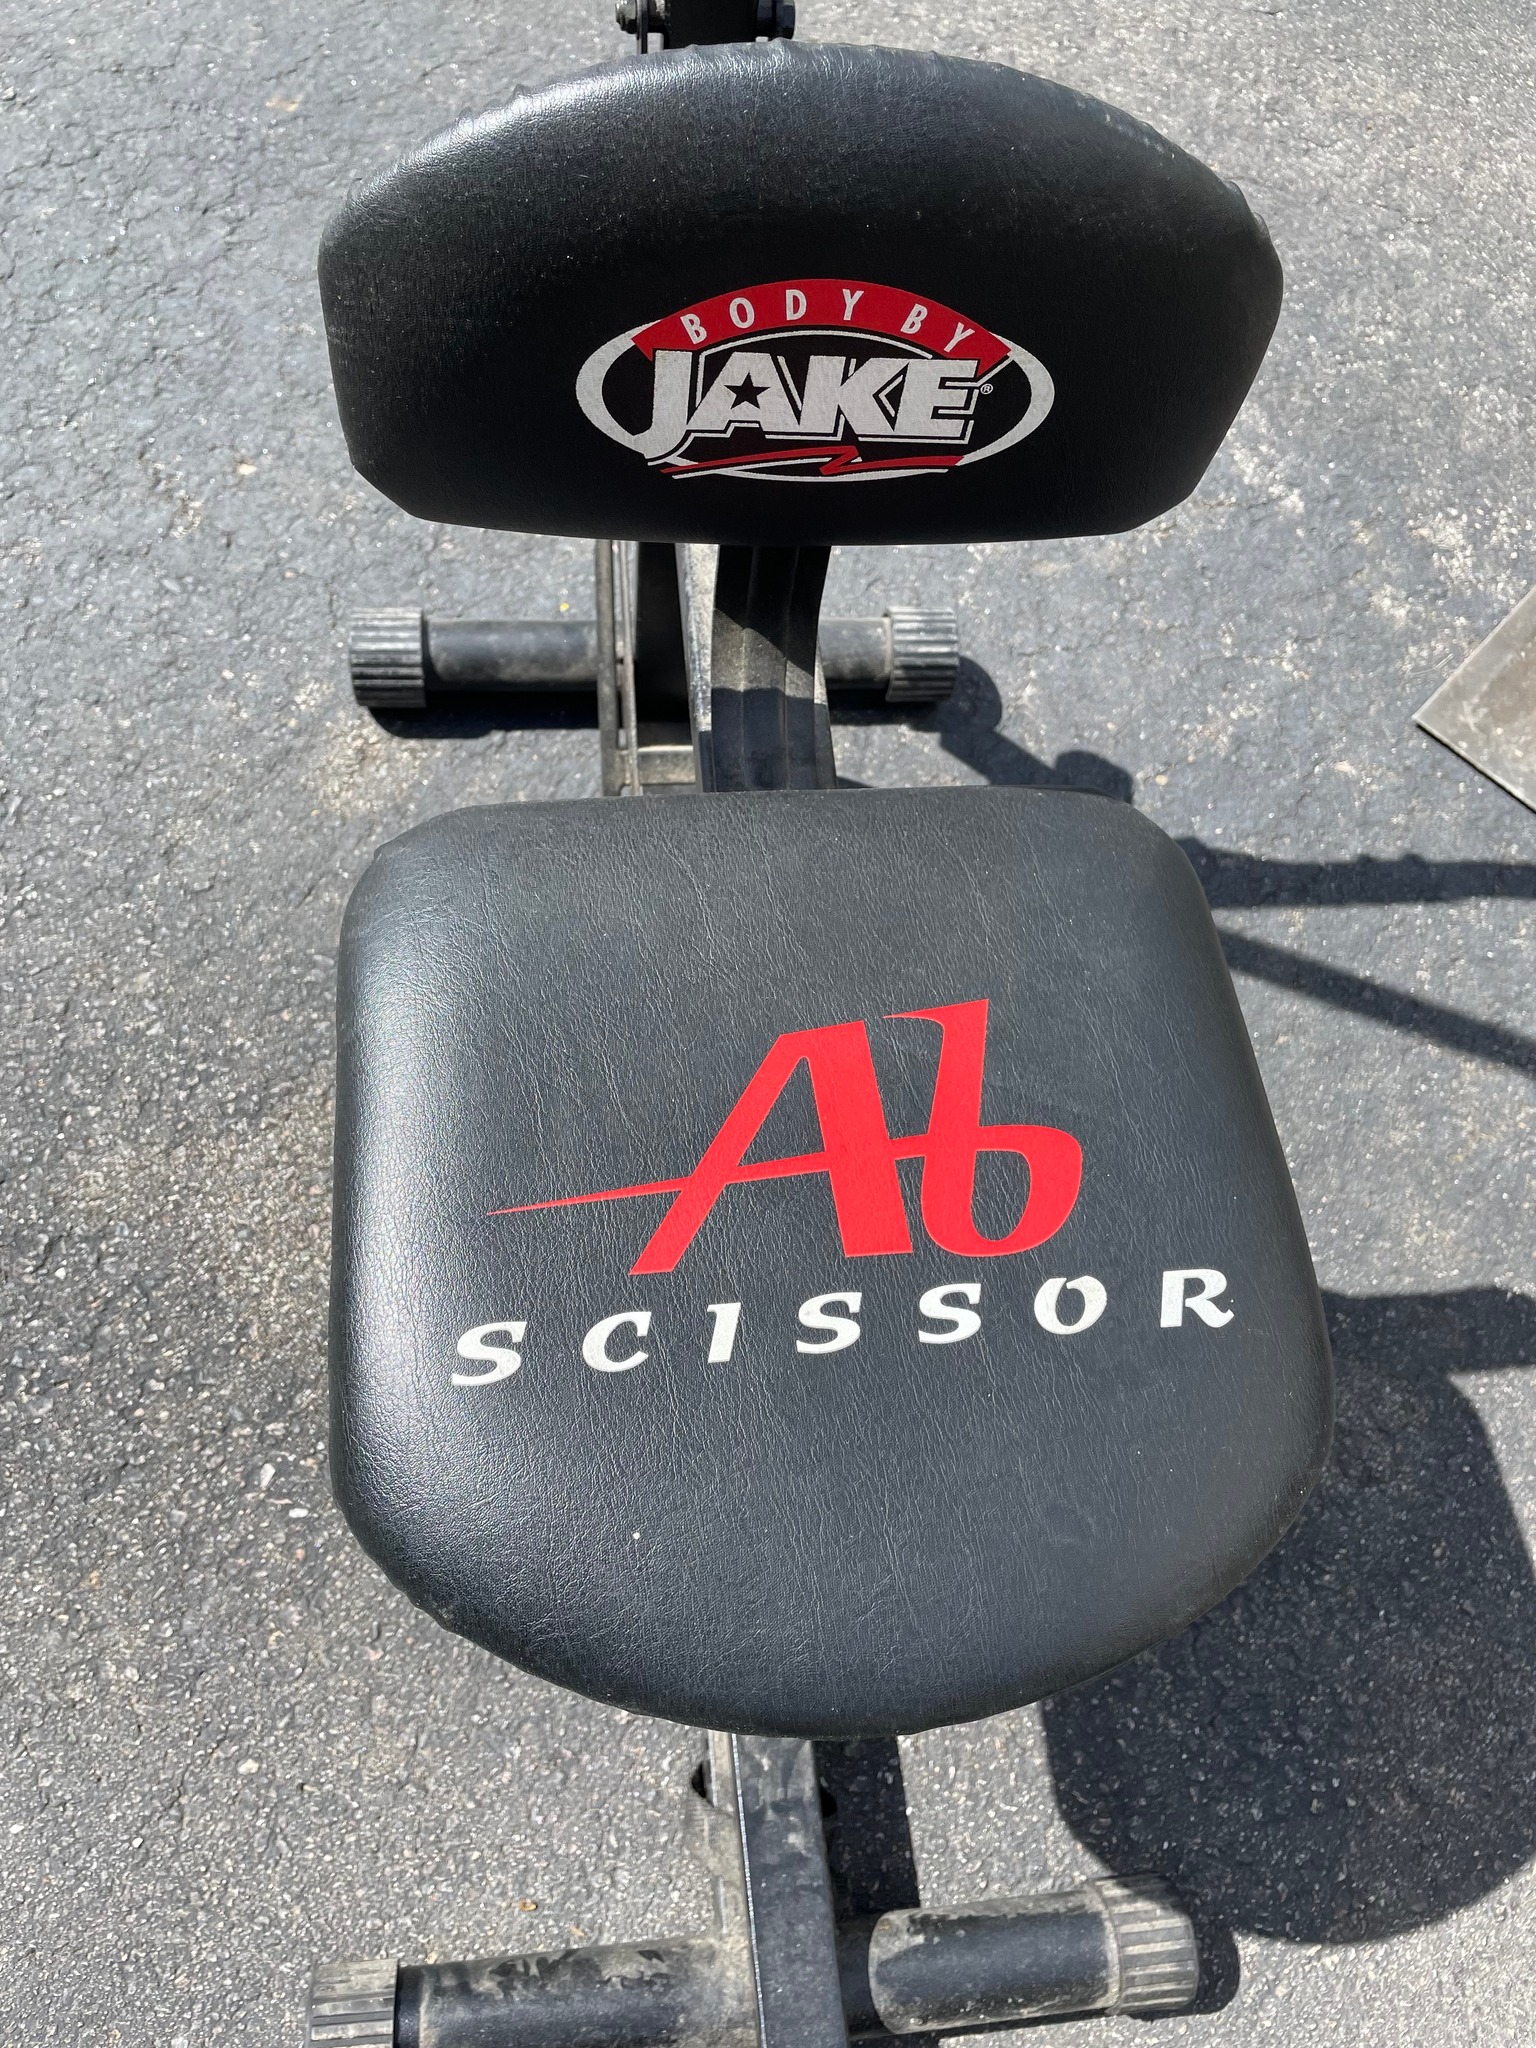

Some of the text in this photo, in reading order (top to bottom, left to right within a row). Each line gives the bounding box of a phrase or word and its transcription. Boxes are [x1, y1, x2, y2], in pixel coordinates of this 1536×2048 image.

[680, 289, 975, 353] BODY BY
[633, 350, 979, 459] JAKE
[487, 999, 1083, 1275] Ab
[451, 1268, 1235, 1387] SCISSOR
